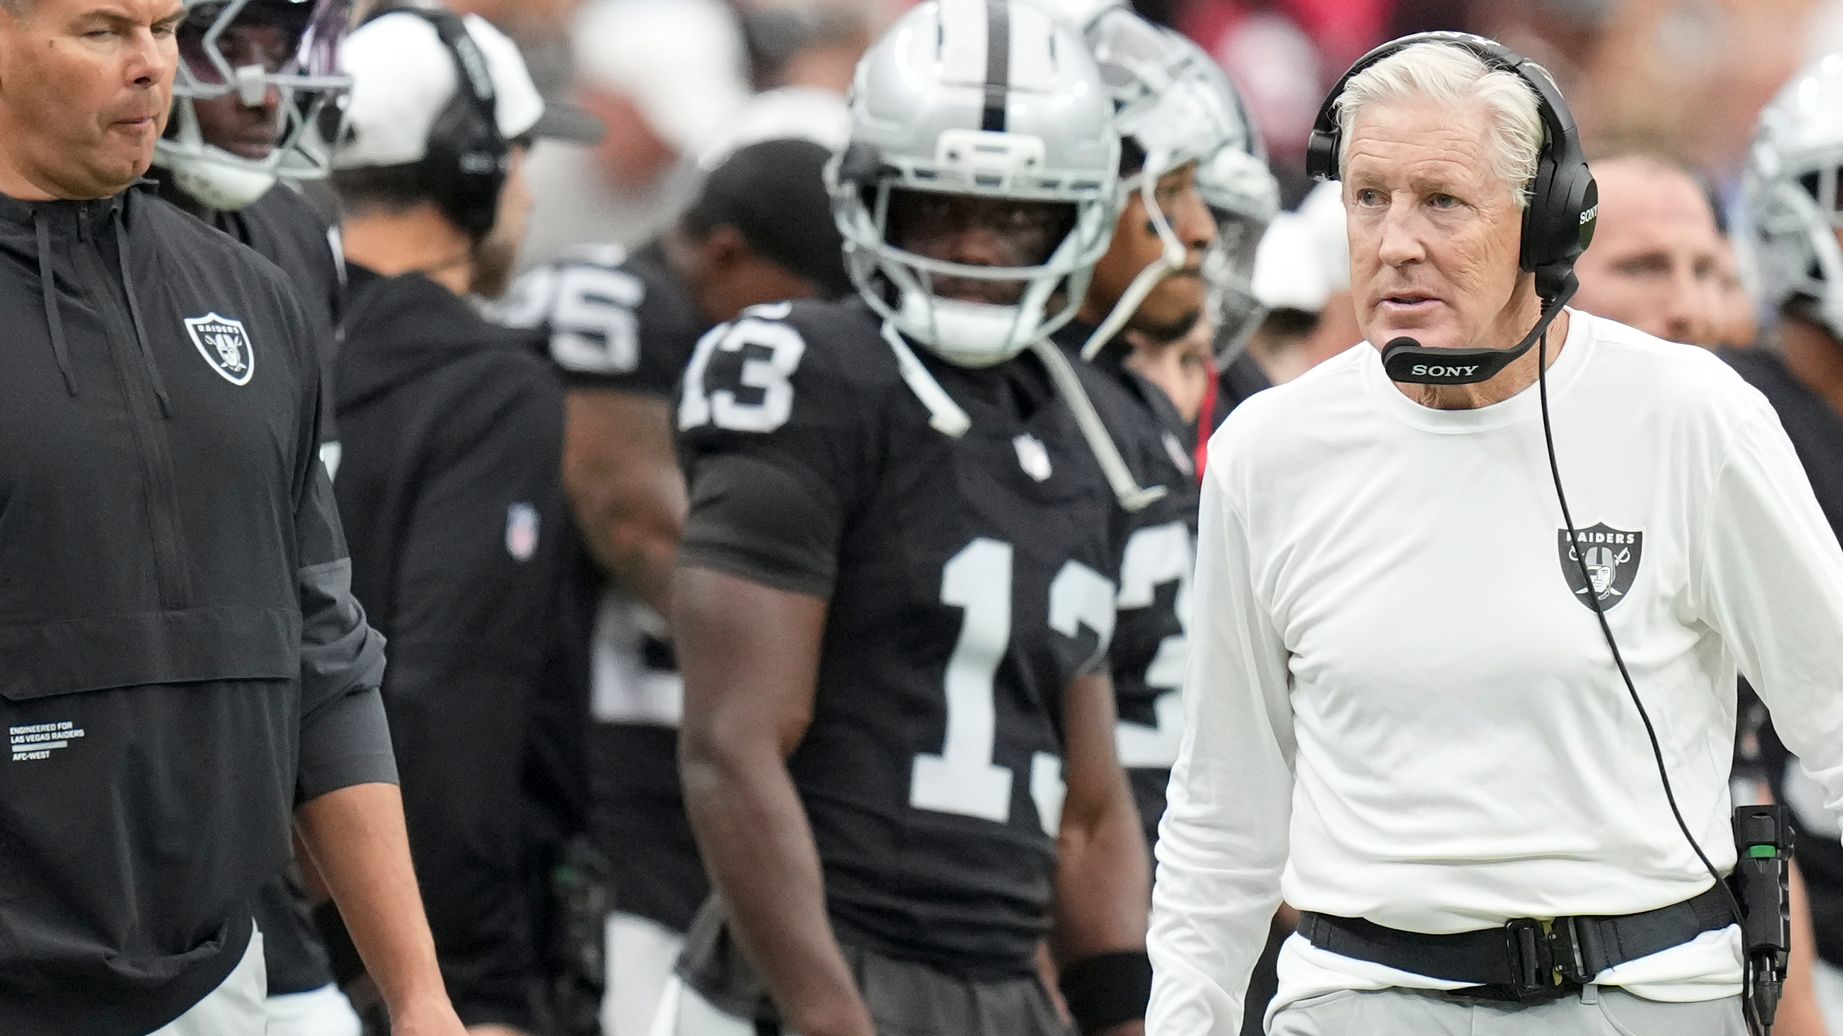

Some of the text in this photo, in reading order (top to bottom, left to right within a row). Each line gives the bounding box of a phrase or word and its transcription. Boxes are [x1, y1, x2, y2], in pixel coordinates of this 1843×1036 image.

[678, 315, 806, 433] 13
[1411, 364, 1479, 377] SONY
[10, 721, 73, 735] ENGINEERED FOR
[11, 728, 85, 744] LAS VEGAS RAIDERS
[12, 750, 50, 761] AFC-WEST
